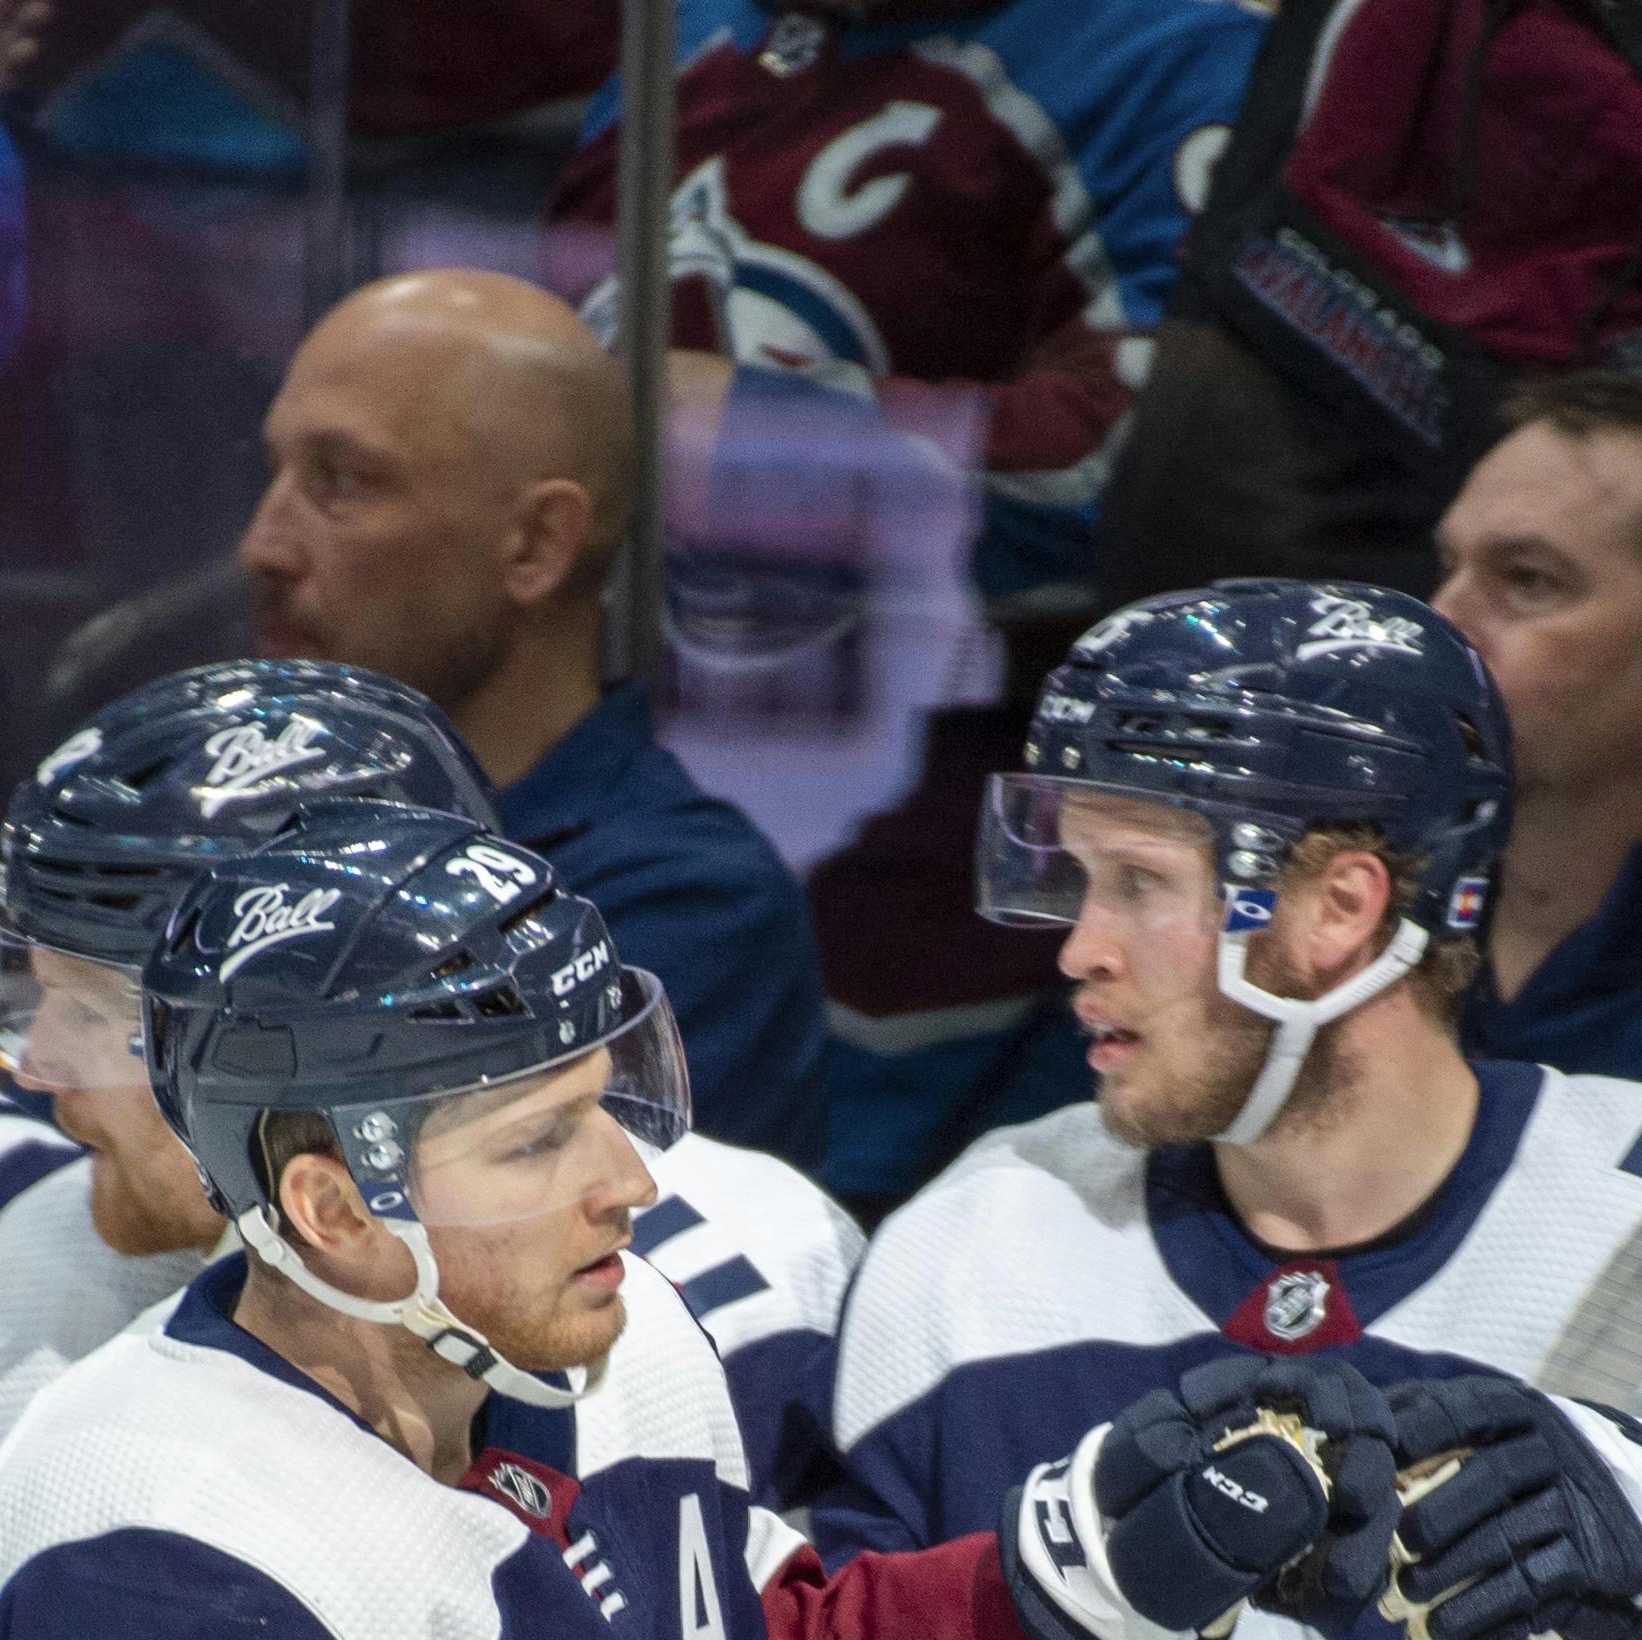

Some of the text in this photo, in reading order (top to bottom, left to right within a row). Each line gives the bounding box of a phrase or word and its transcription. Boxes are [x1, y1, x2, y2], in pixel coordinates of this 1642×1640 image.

[797, 100, 943, 240] C
[444, 844, 538, 904] 29
[218, 882, 343, 982] Ball
[550, 939, 611, 997] CCM
[1201, 1464, 1270, 1514] CCM
